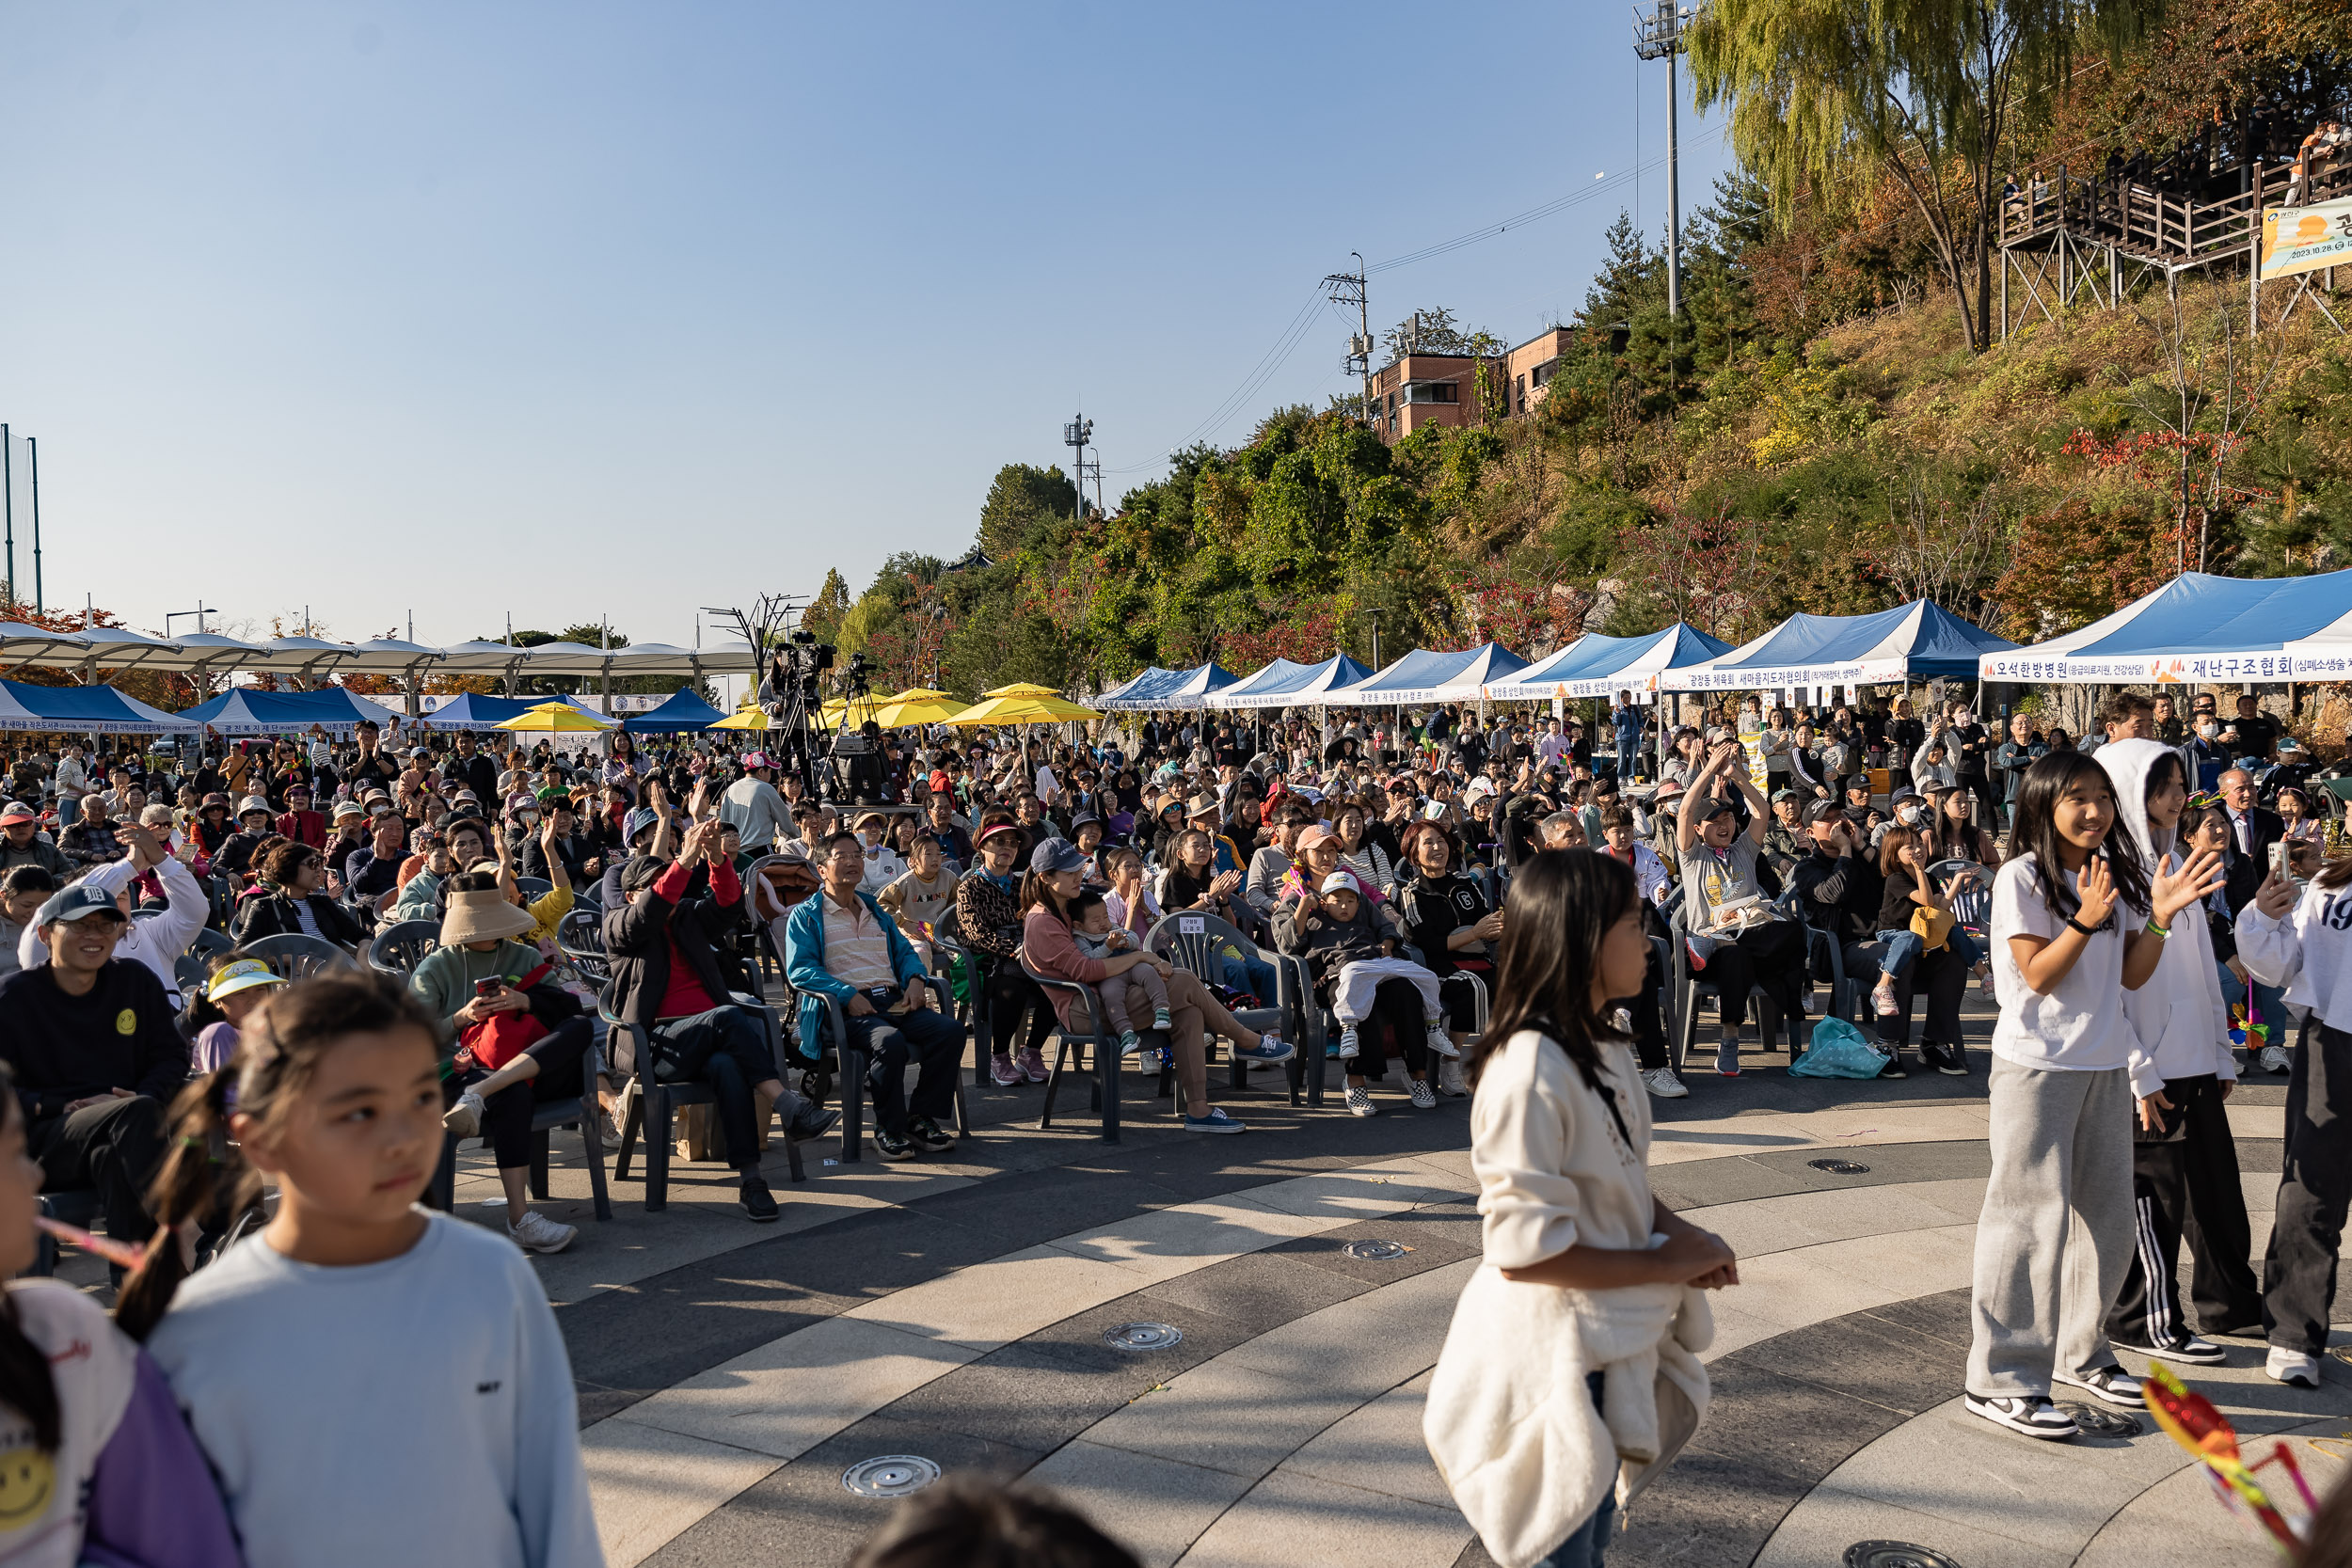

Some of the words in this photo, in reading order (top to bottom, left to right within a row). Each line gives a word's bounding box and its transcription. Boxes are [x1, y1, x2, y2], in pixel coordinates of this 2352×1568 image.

[1997, 661, 2067, 678] 오석한방병원
[2113, 664, 2144, 675] 건강상담)
[2192, 657, 2293, 678] 재난구조협회
[2295, 657, 2345, 673] (심폐소생술
[1691, 673, 1711, 687] 광장동
[1713, 673, 1735, 686] 체육회
[1740, 670, 1810, 686] 새마을지도자협의회
[1573, 682, 1592, 694] 광장동
[1595, 681, 1613, 693] 상인회
[1361, 692, 1379, 703] 광장동
[9, 721, 27, 729] 새마을
[29, 721, 59, 731] 작은도서관
[225, 724, 278, 733] 광진복지재단
[913, 891, 947, 904] JASMINE
